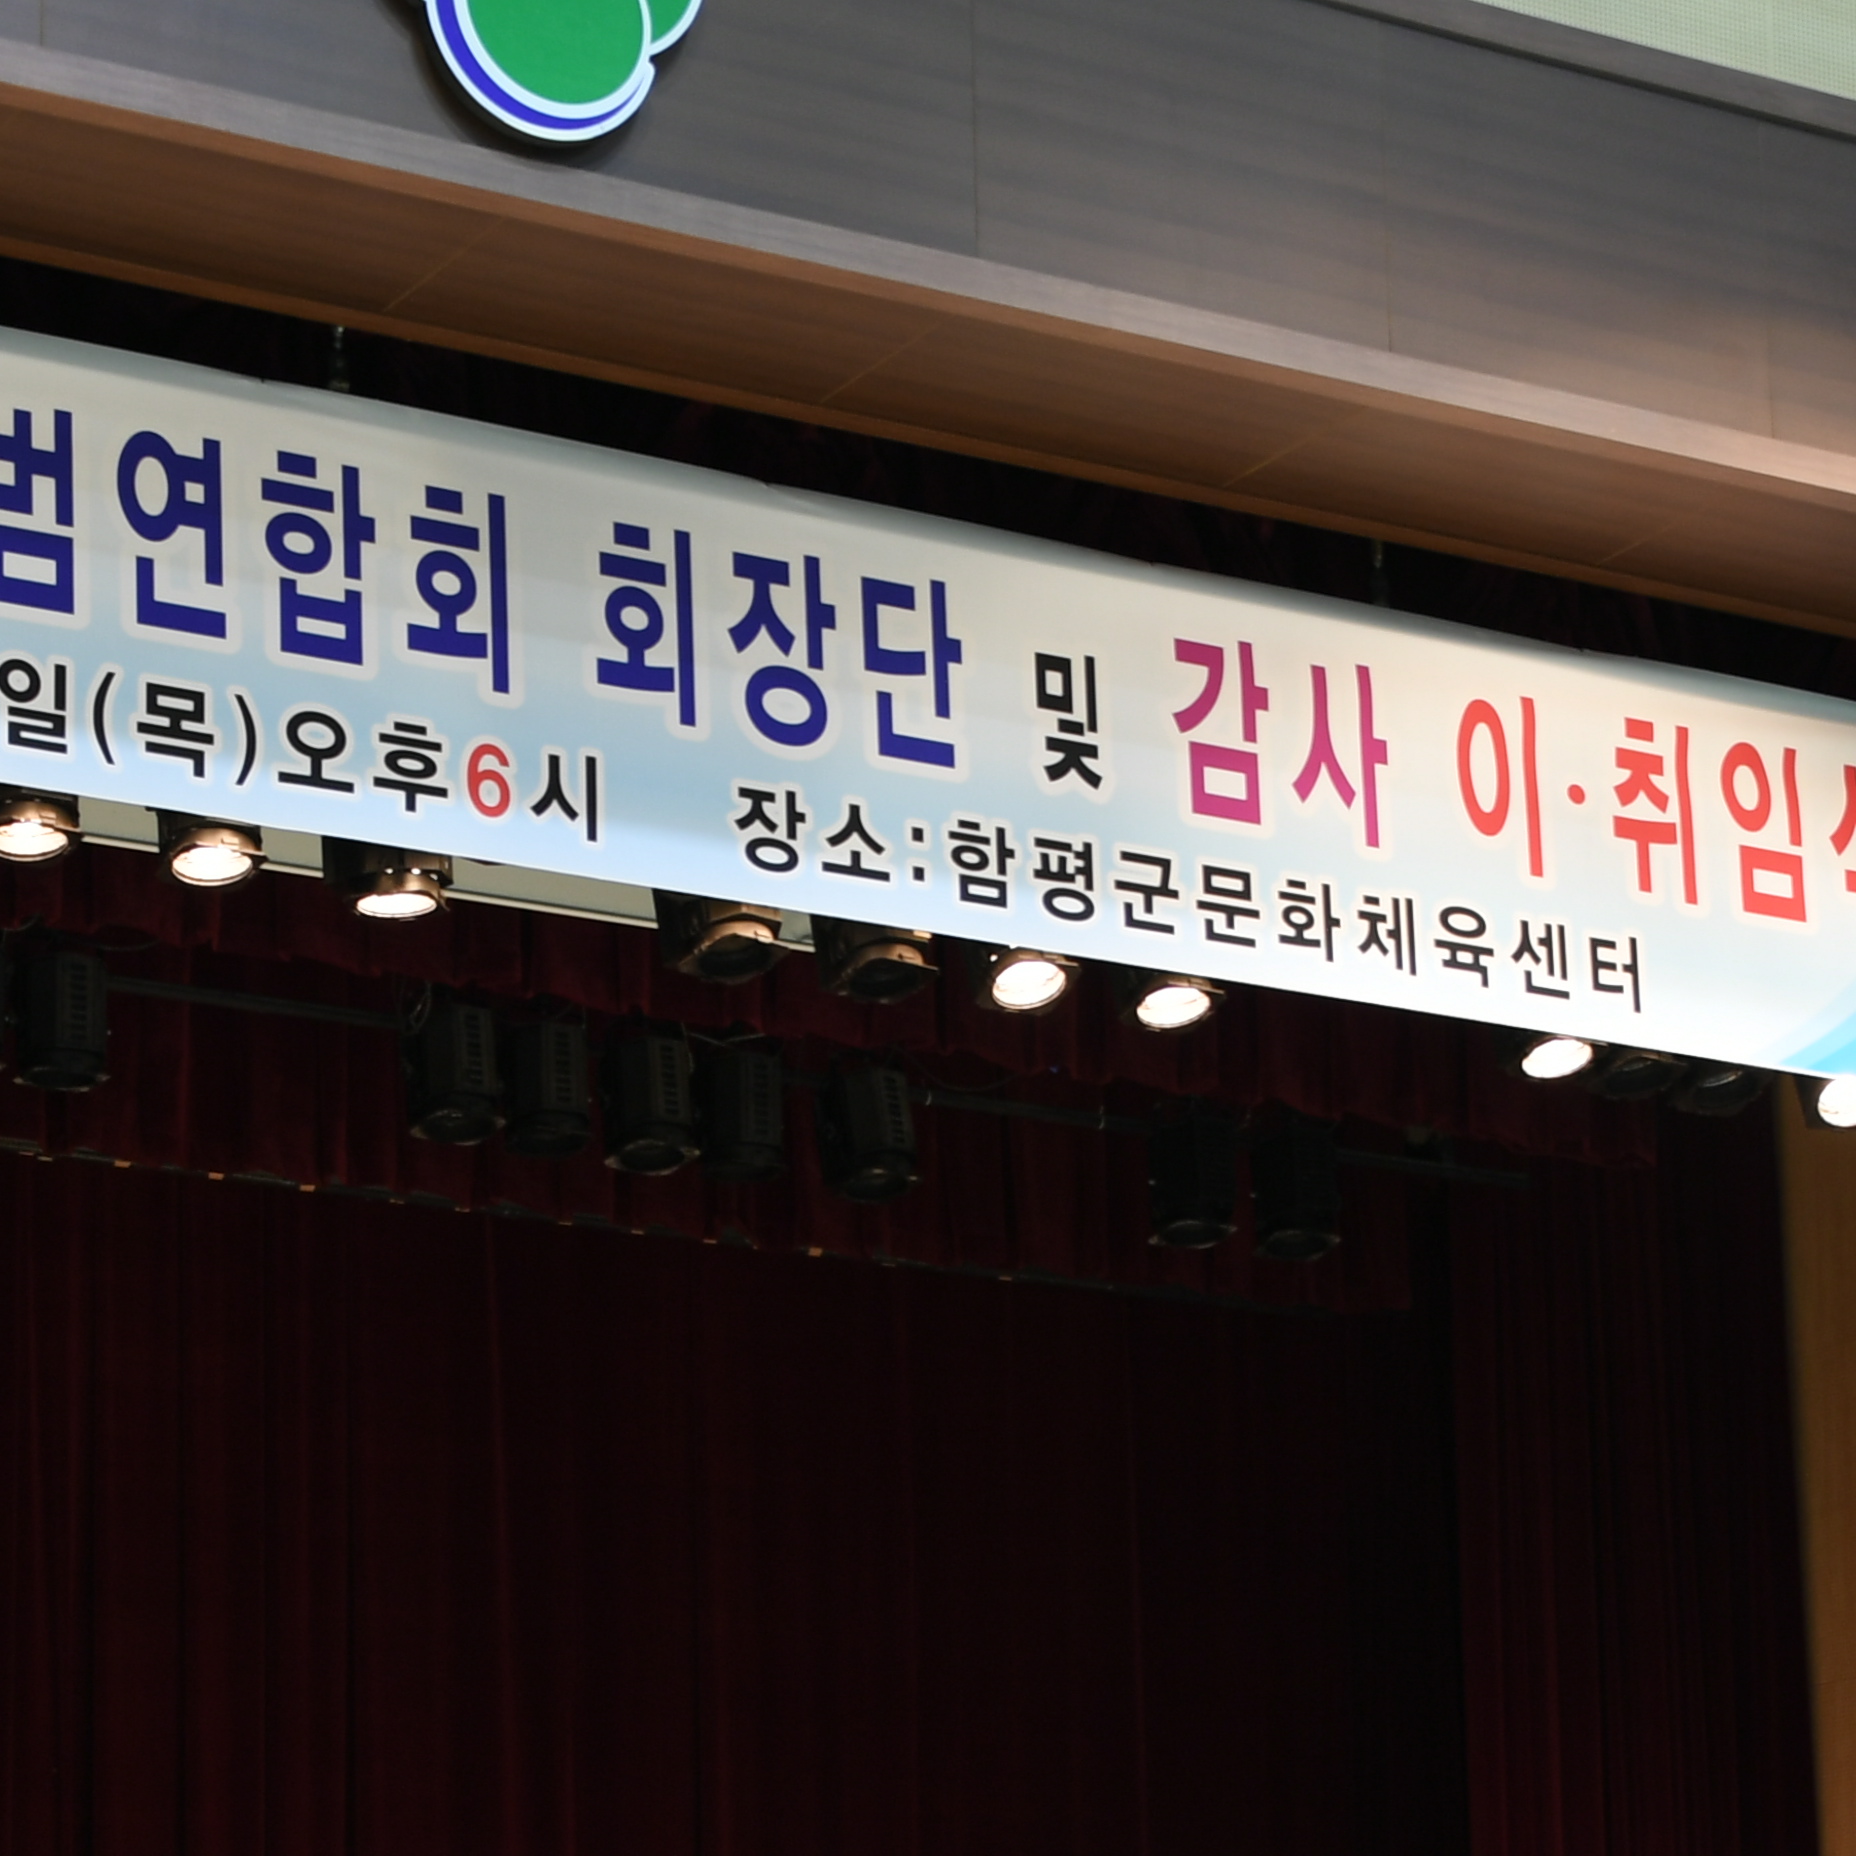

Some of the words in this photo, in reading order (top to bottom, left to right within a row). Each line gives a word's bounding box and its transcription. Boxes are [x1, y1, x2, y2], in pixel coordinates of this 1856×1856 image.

[597, 522, 963, 769] 회장단
[1034, 651, 1103, 790] 및
[1172, 637, 1389, 850] 감사
